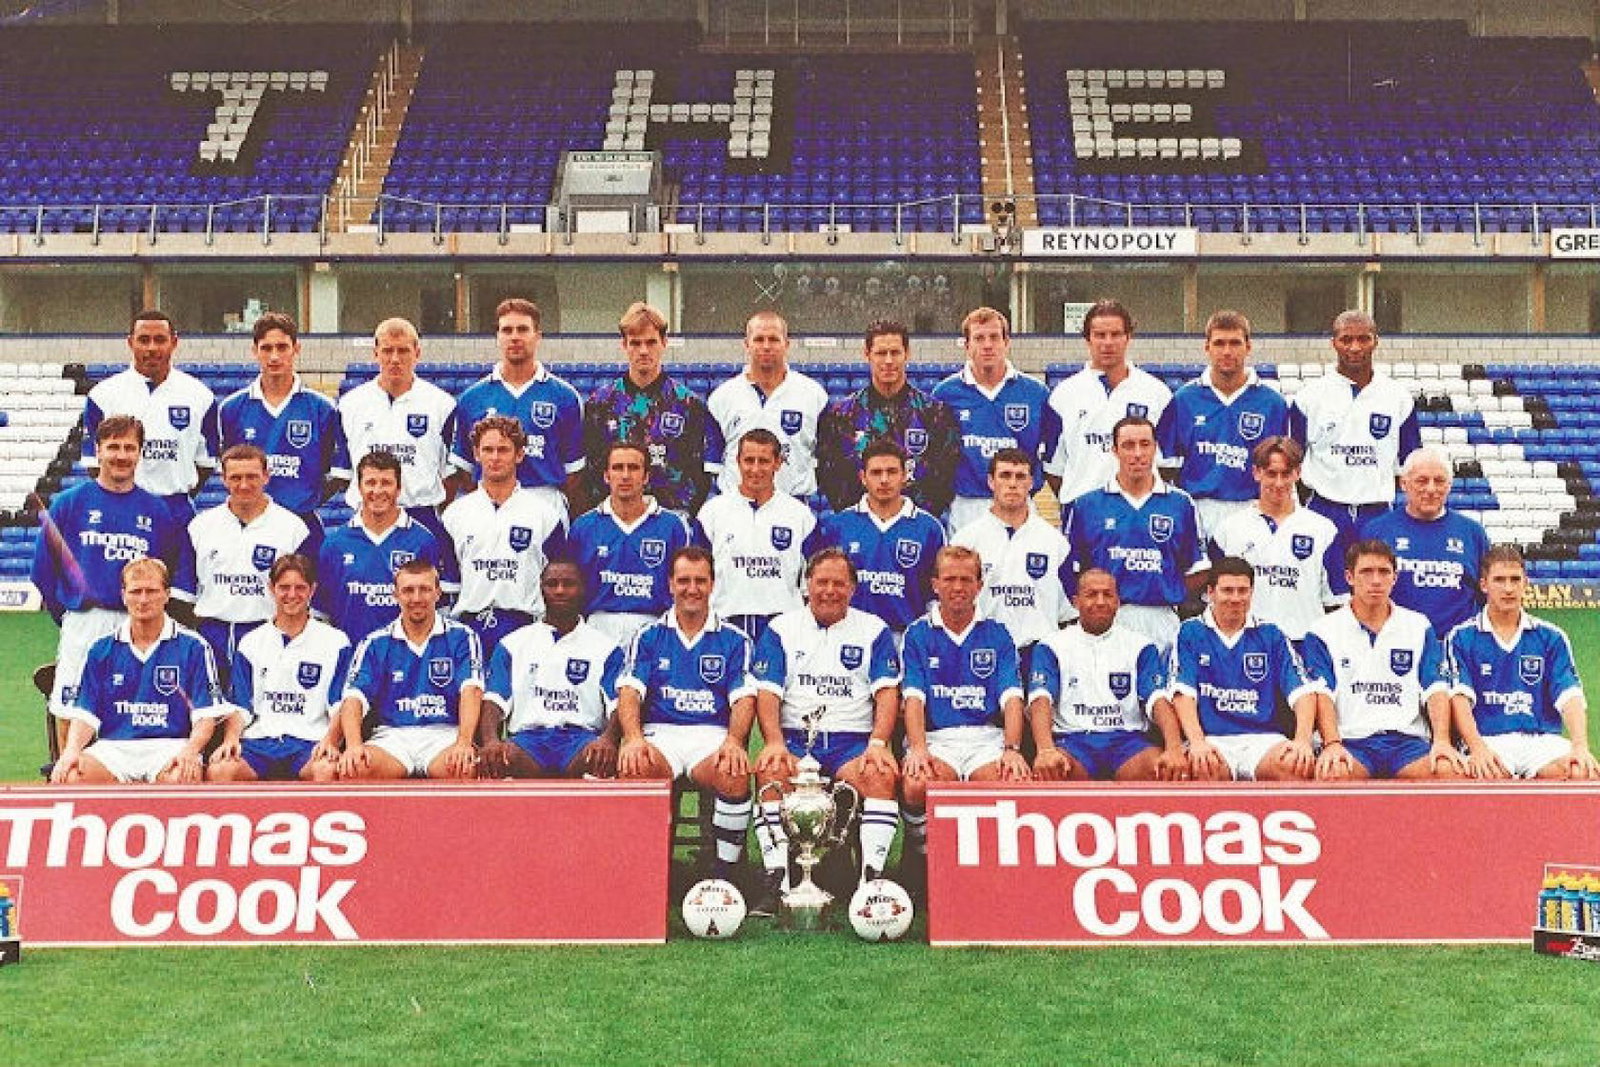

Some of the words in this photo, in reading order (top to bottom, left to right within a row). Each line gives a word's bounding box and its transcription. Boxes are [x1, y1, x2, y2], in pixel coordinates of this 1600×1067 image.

[1042, 233, 1177, 250] REYNOPOLY
[1555, 234, 1600, 252] GRE
[143, 439, 179, 448] omas
[79, 530, 149, 551] Thomas
[732, 556, 782, 568] Thomas
[1396, 556, 1465, 575] homas
[746, 567, 782, 579] Cook
[1413, 572, 1462, 590] Cook
[798, 674, 854, 687] Thomas
[1351, 680, 1403, 694] Thomas
[816, 684, 854, 698] Cook
[1199, 682, 1260, 702] Thomas
[1216, 699, 1259, 714] Cook
[0, 801, 369, 868] Thomas
[933, 799, 1322, 868] Thomas
[110, 866, 360, 940] Cook
[1073, 864, 1332, 940] Cook
